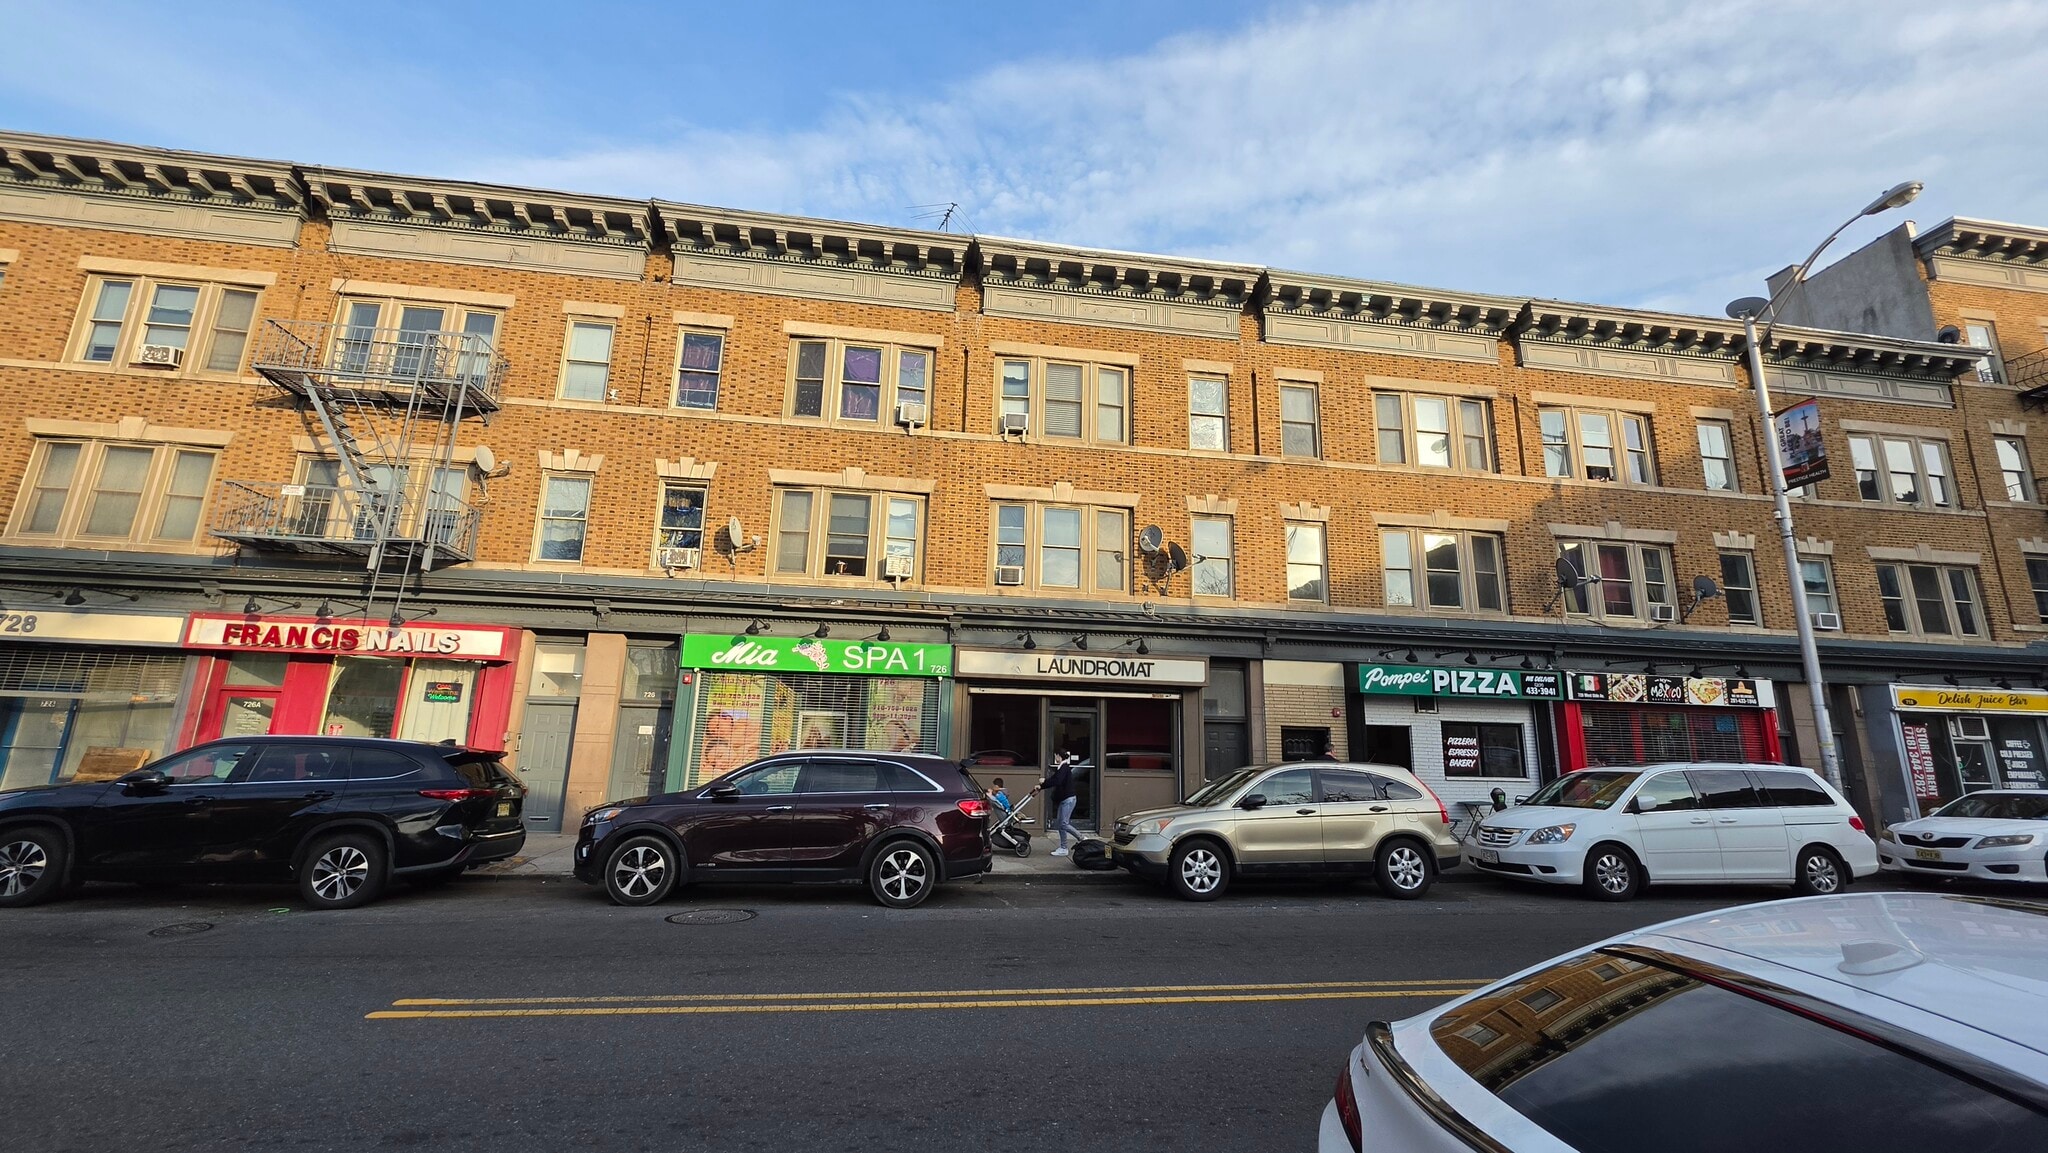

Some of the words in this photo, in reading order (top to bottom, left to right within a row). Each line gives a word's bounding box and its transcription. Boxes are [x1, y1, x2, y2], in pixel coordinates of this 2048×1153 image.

[1779, 427, 1787, 447] GREAT
[1785, 429, 1792, 438] TO
[1787, 438, 1796, 459] PLACE
[1809, 469, 1827, 478] HEALTH
[222, 623, 360, 650] FRANCIS
[366, 627, 461, 654] NAILS
[711, 641, 779, 667] Mia
[842, 645, 909, 671] SPA
[913, 648, 925, 671] 1
[930, 665, 947, 674] 726
[1037, 657, 1155, 678] LAUNDROMAT
[1364, 667, 1431, 690] Pompei
[1433, 669, 1518, 696] PIZZA
[1937, 692, 1973, 705] Delish
[1975, 694, 2004, 708] Juice
[2006, 694, 2028, 706] Bar
[1447, 737, 1477, 746] PIZZERIA
[1915, 727, 1931, 754] STORE
[2005, 740, 2023, 748] COFFEE
[1448, 748, 1479, 757] ESPRESSO
[2000, 750, 2012, 758] COLD
[2012, 751, 2034, 759] PRESSED
[1449, 759, 1476, 768] BAKERY
[1922, 754, 1935, 774] FOR
[1909, 752, 1927, 798] 344-2821
[2007, 771, 2036, 779] EMPANADAS
[1927, 774, 1939, 797] RENT
